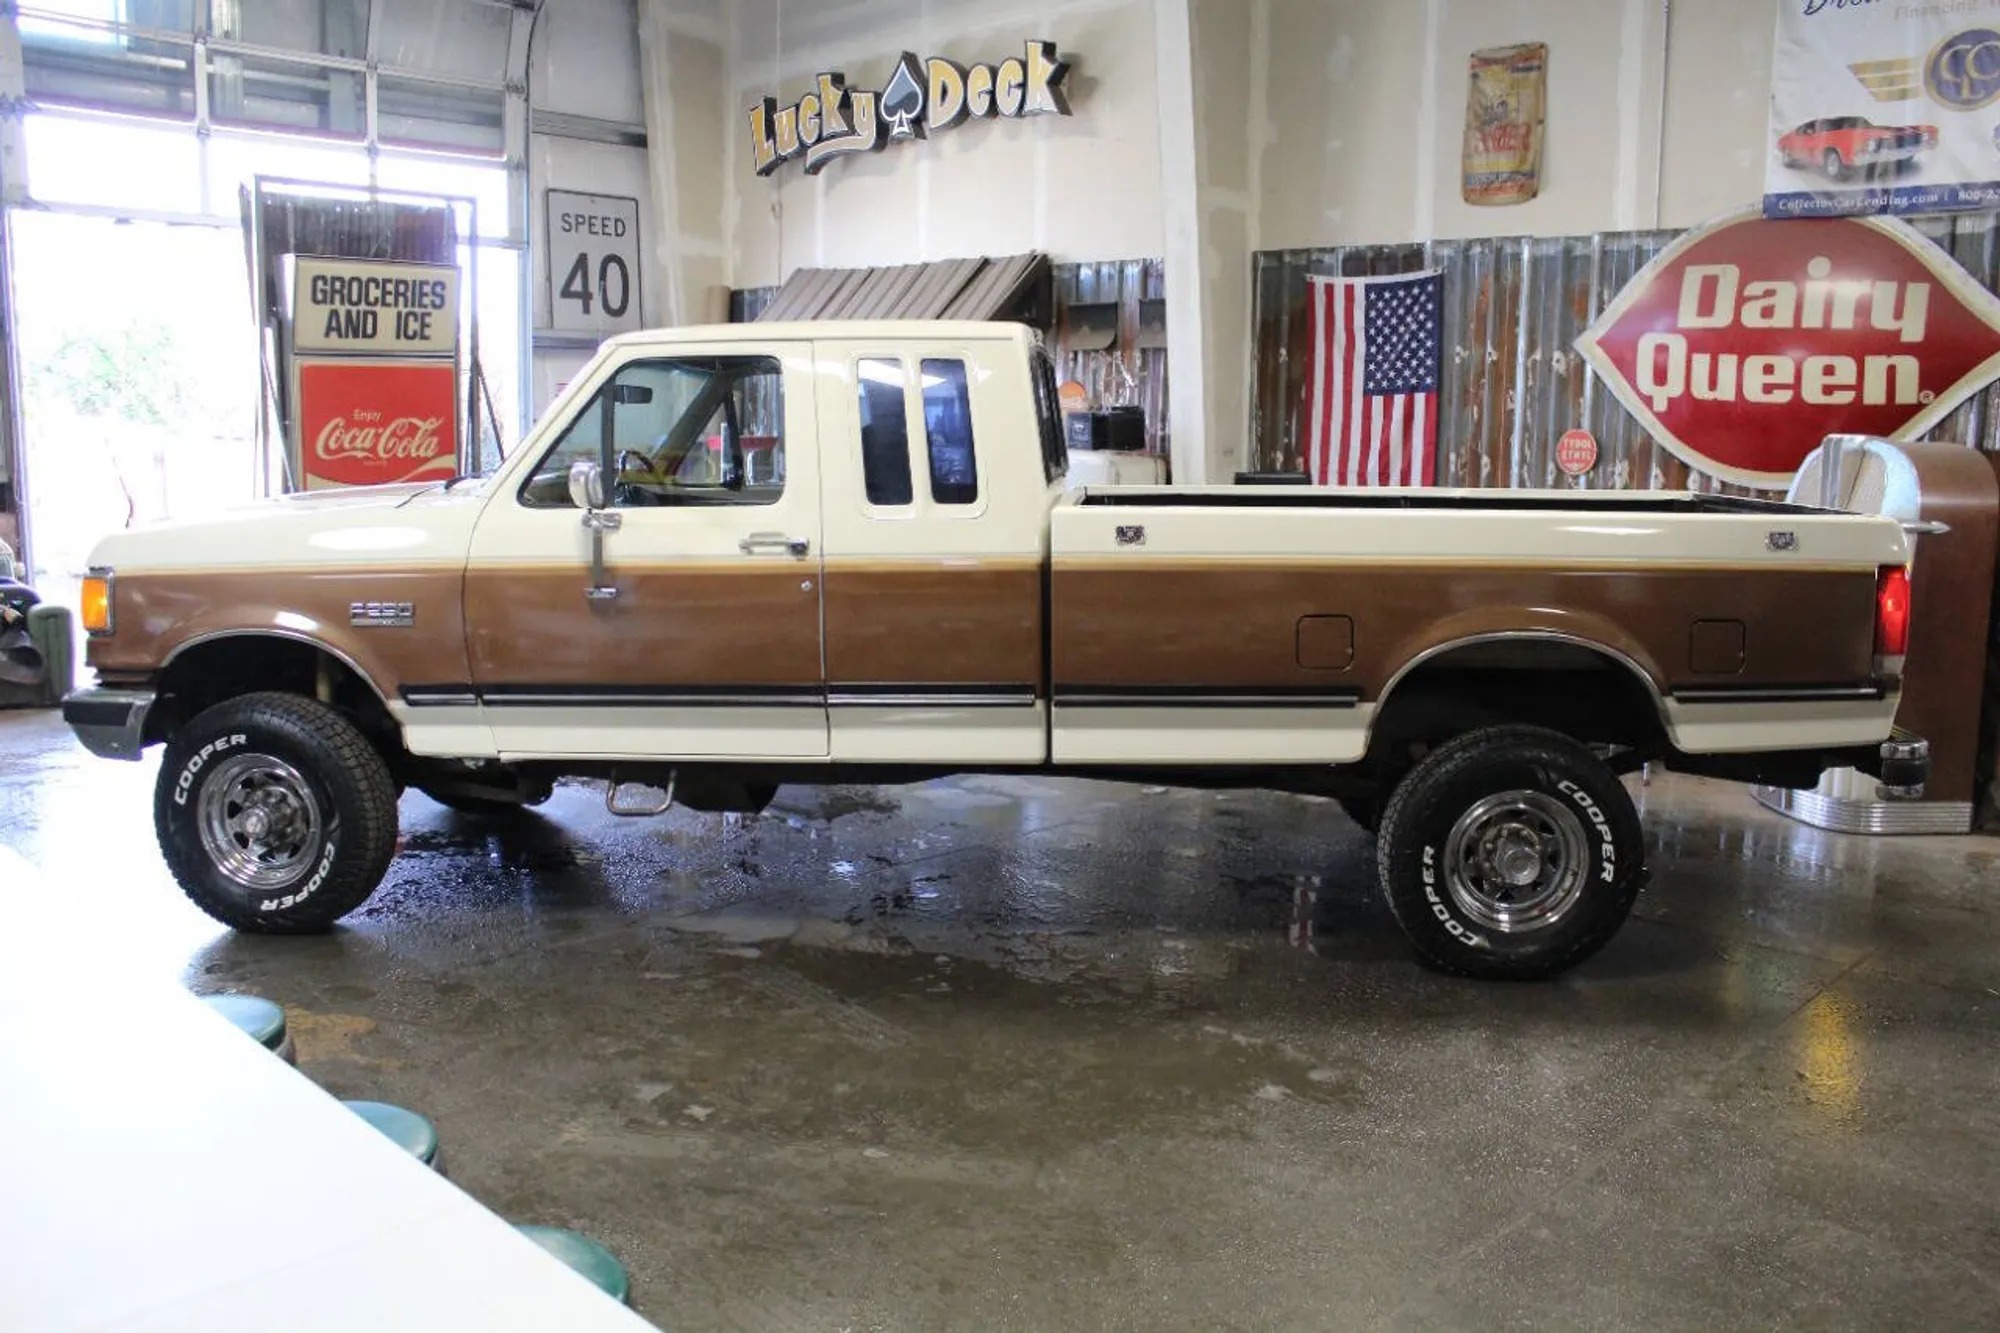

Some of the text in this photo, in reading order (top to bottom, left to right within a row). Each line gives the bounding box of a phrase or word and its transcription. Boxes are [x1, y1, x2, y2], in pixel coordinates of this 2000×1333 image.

[750, 40, 1072, 175] Lucky Deck
[561, 213, 626, 238] SPEED
[311, 275, 446, 309] GROCERIES
[560, 253, 629, 317] 40
[1677, 256, 1930, 342] Dairy
[324, 309, 432, 340] AND ICE
[1636, 332, 1920, 413] Queen
[316, 416, 443, 460] Coca-Cola
[174, 734, 247, 805] COOPER
[1557, 780, 1616, 882] COOPER
[261, 842, 335, 911] COOPER
[1422, 845, 1479, 947] COOPER
